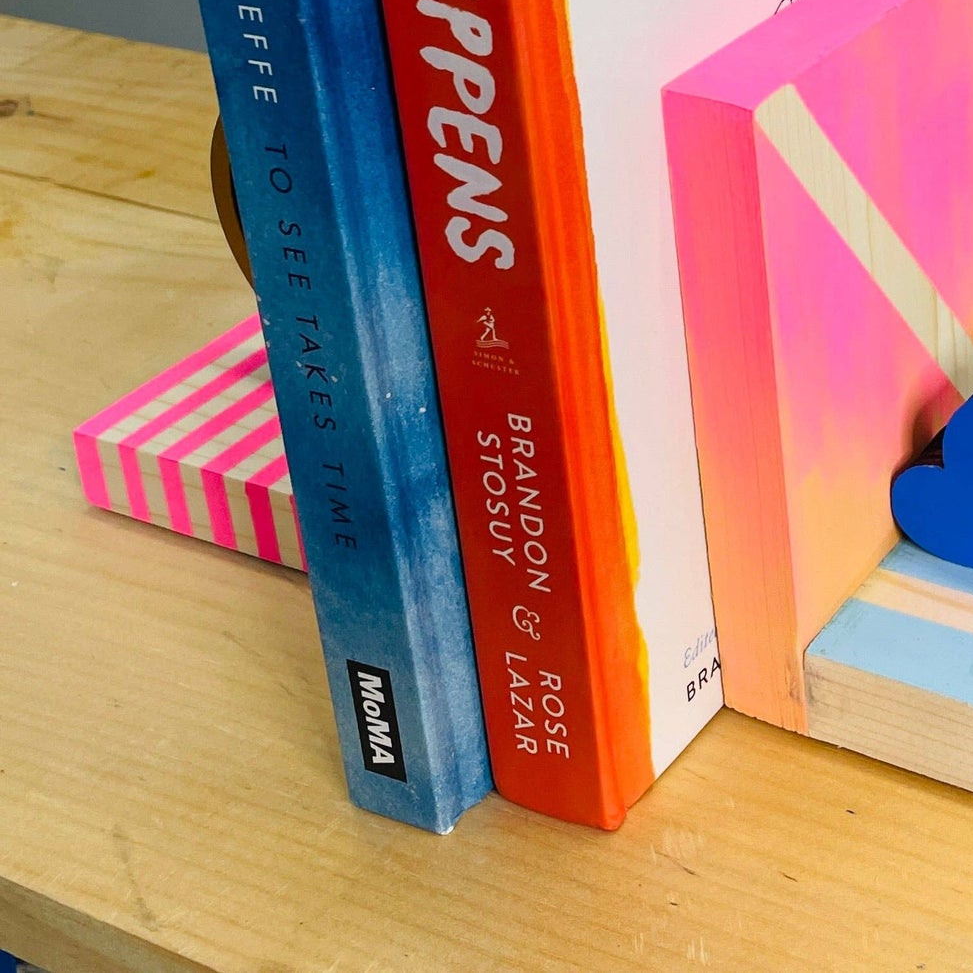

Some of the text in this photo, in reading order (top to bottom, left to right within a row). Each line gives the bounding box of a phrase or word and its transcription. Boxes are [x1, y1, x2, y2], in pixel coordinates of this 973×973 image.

[265, 143, 293, 194] TO
[278, 219, 311, 290] SEE
[295, 314, 336, 431] TAKES
[471, 359, 520, 376] SCHUSTER
[473, 350, 504, 362] SIMON
[322, 462, 357, 551] TIME
[476, 430, 516, 566] STOSUY
[507, 413, 551, 593] BRANDON
[511, 605, 541, 641] &
[357, 670, 395, 765] MoMA
[504, 652, 538, 756] LAZAR
[538, 669, 570, 759] ROSE
